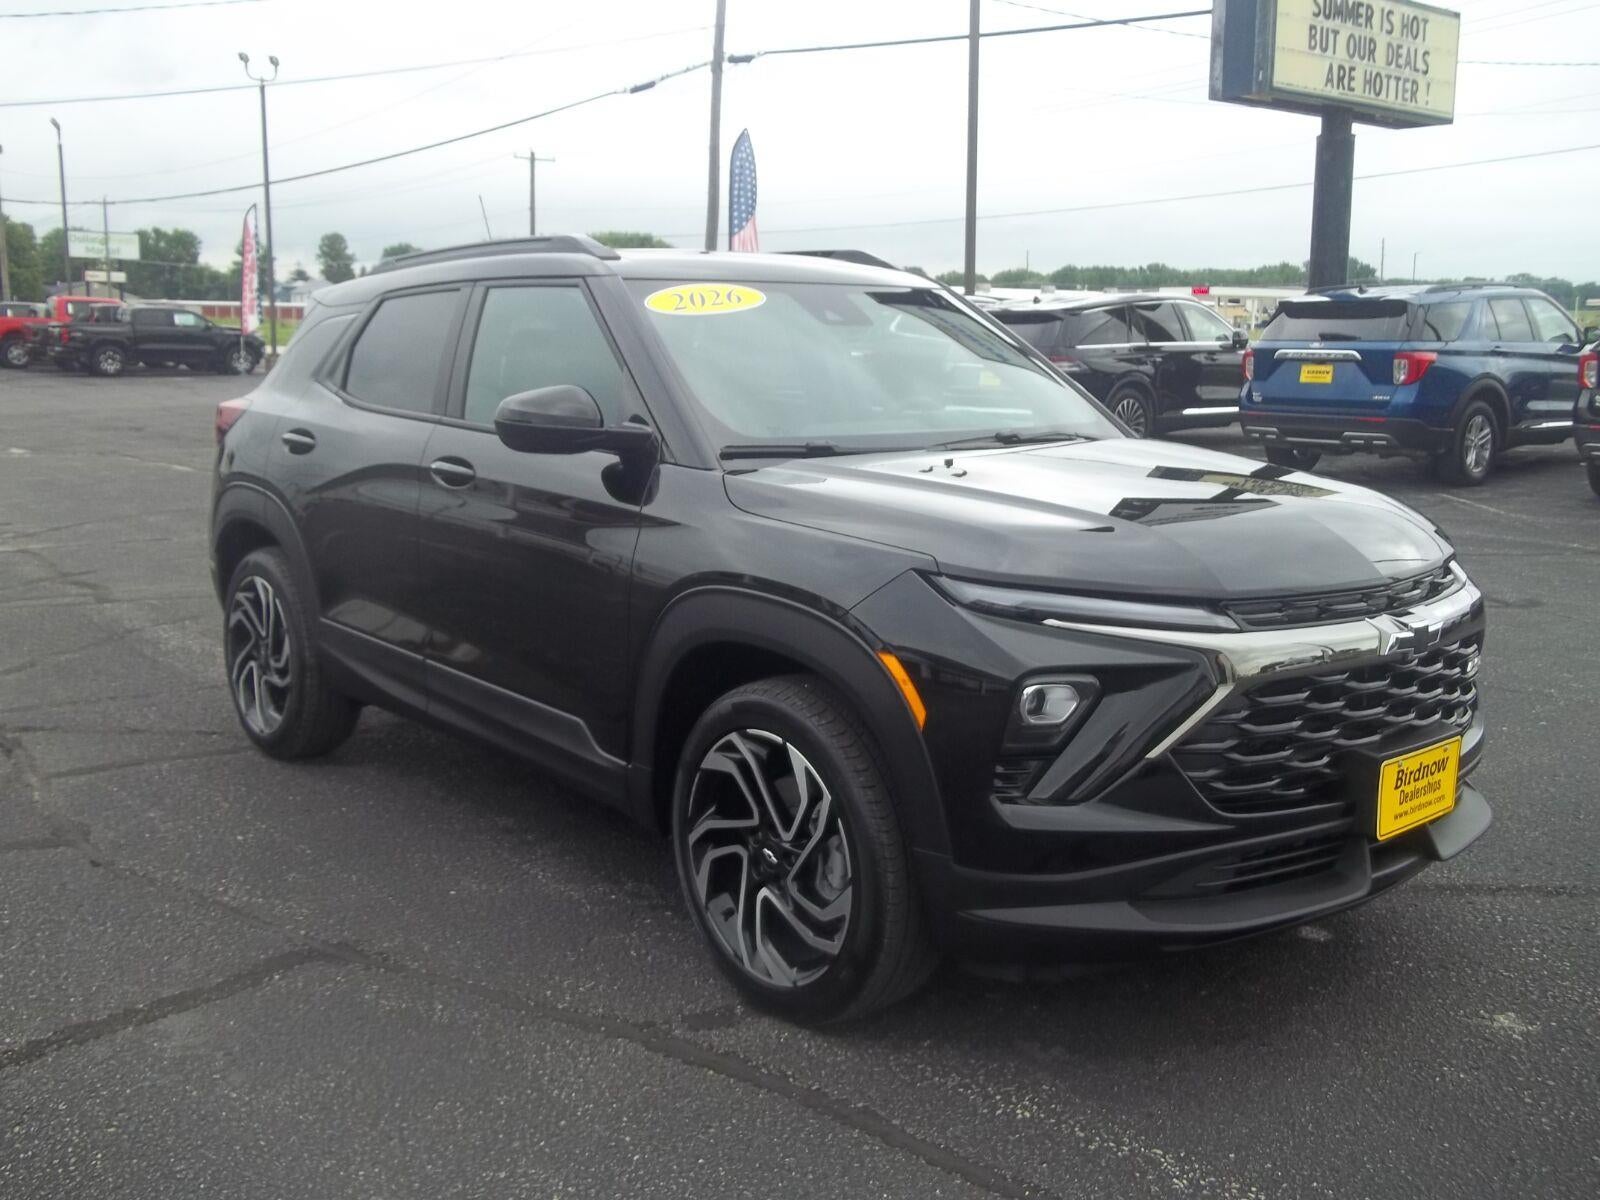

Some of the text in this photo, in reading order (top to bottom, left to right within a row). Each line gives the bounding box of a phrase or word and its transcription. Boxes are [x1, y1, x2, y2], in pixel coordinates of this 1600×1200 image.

[1312, 0, 1429, 42] SUMMER IS HOT
[1308, 23, 1430, 75] BUT OUR DEALS
[1325, 62, 1356, 92] ARE
[671, 289, 742, 311] 2026
[1393, 756, 1449, 790] Birdnow
[1393, 794, 1445, 820] www.birdnow.com
[1399, 778, 1441, 806] Dealerships
